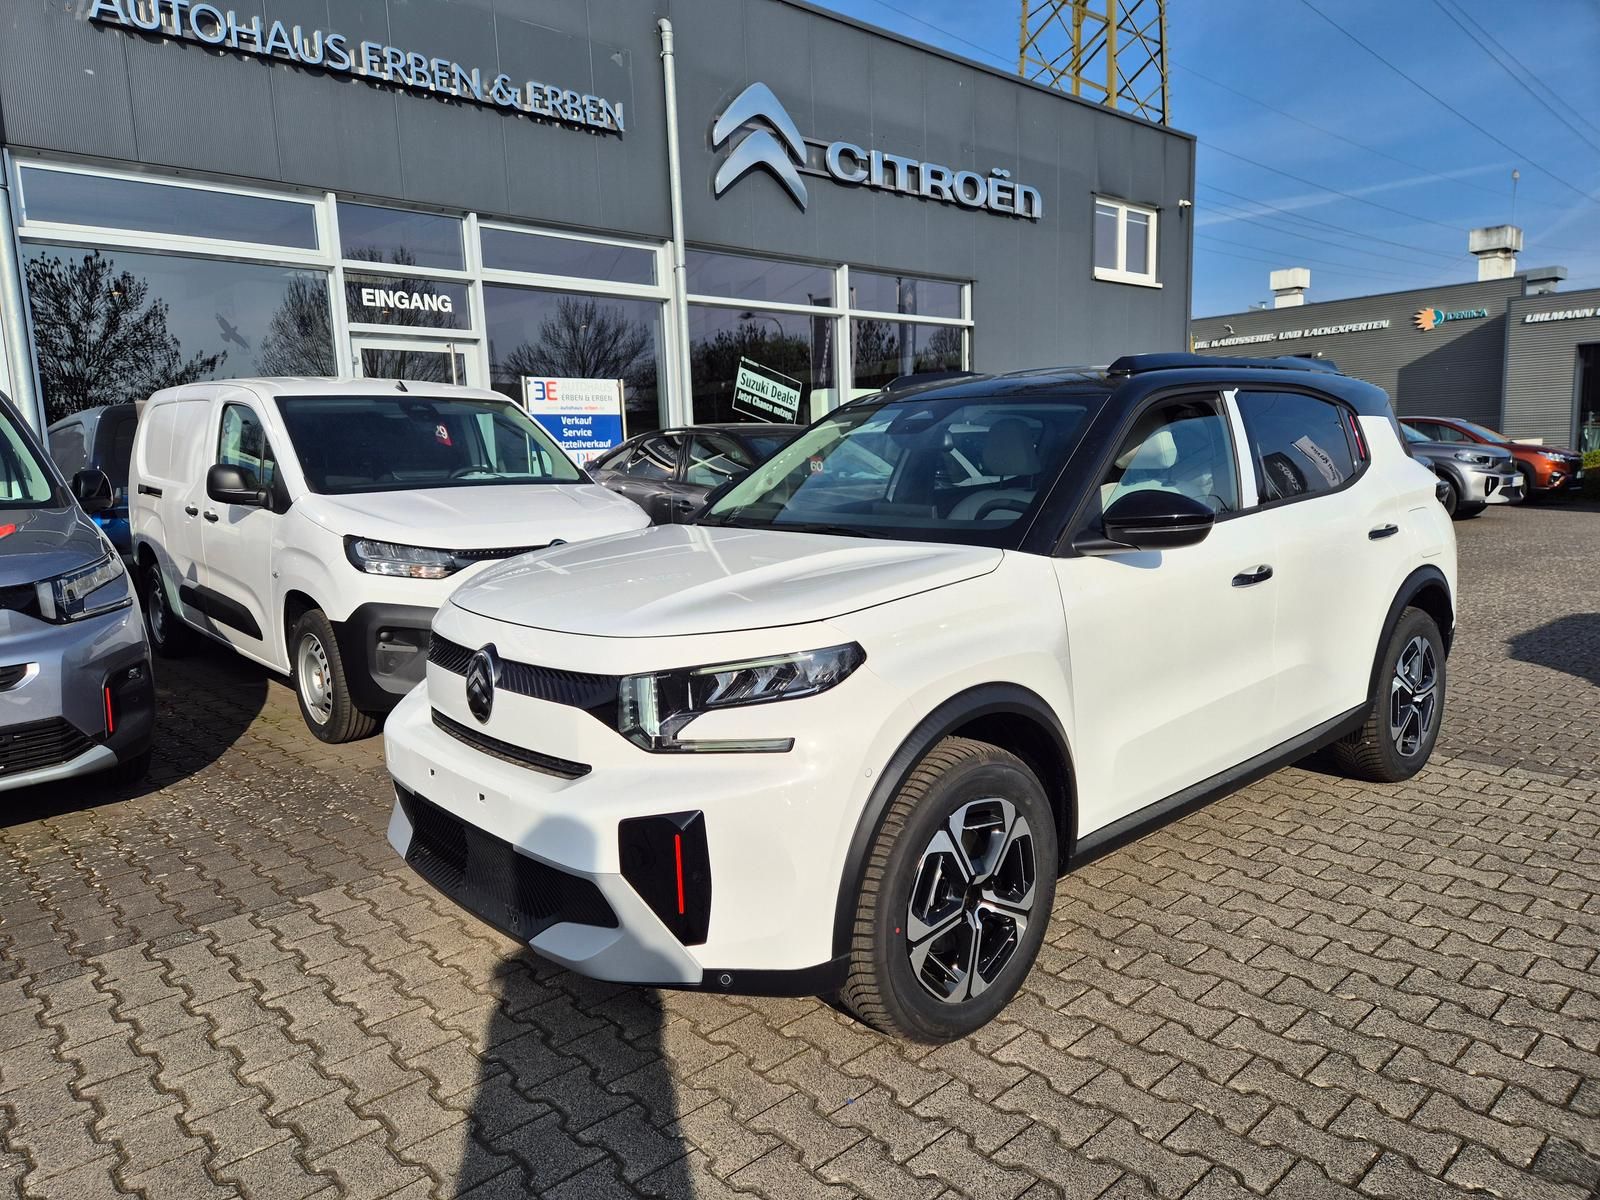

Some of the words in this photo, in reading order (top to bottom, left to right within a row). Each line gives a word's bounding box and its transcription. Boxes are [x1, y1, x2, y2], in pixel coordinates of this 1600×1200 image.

[89, 0, 351, 70] AUTOHAUS
[360, 41, 483, 100] ERBEN
[490, 73, 522, 109] &
[526, 81, 625, 132] ERBEN
[825, 141, 1043, 219] CITROËN
[361, 287, 453, 313] EINGANG
[1278, 330, 1303, 340] UND
[740, 372, 770, 395] Suzuki
[770, 385, 797, 407] Deals!
[561, 416, 592, 425] Verkauf
[563, 428, 592, 437] Service
[560, 439, 612, 449] tzteilverkauf
[810, 460, 823, 472] 60
